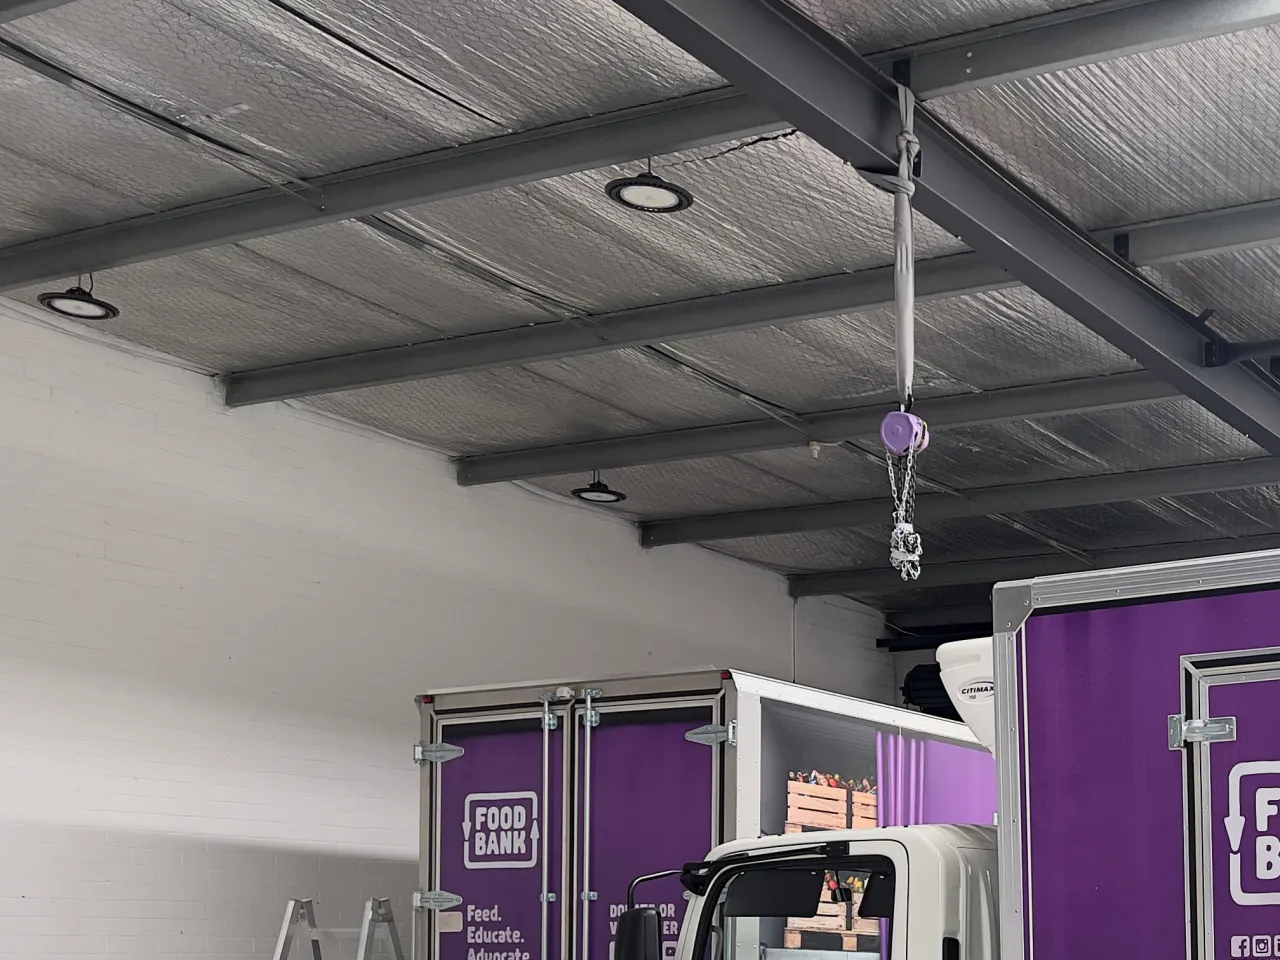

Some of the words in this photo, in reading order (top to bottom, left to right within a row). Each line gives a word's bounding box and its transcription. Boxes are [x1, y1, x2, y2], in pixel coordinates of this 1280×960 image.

[961, 686, 994, 694] CITIMAX
[475, 805, 526, 830] FOOD
[474, 830, 526, 855] BANK
[467, 904, 502, 922] Feed.
[467, 926, 524, 943] Educate.
